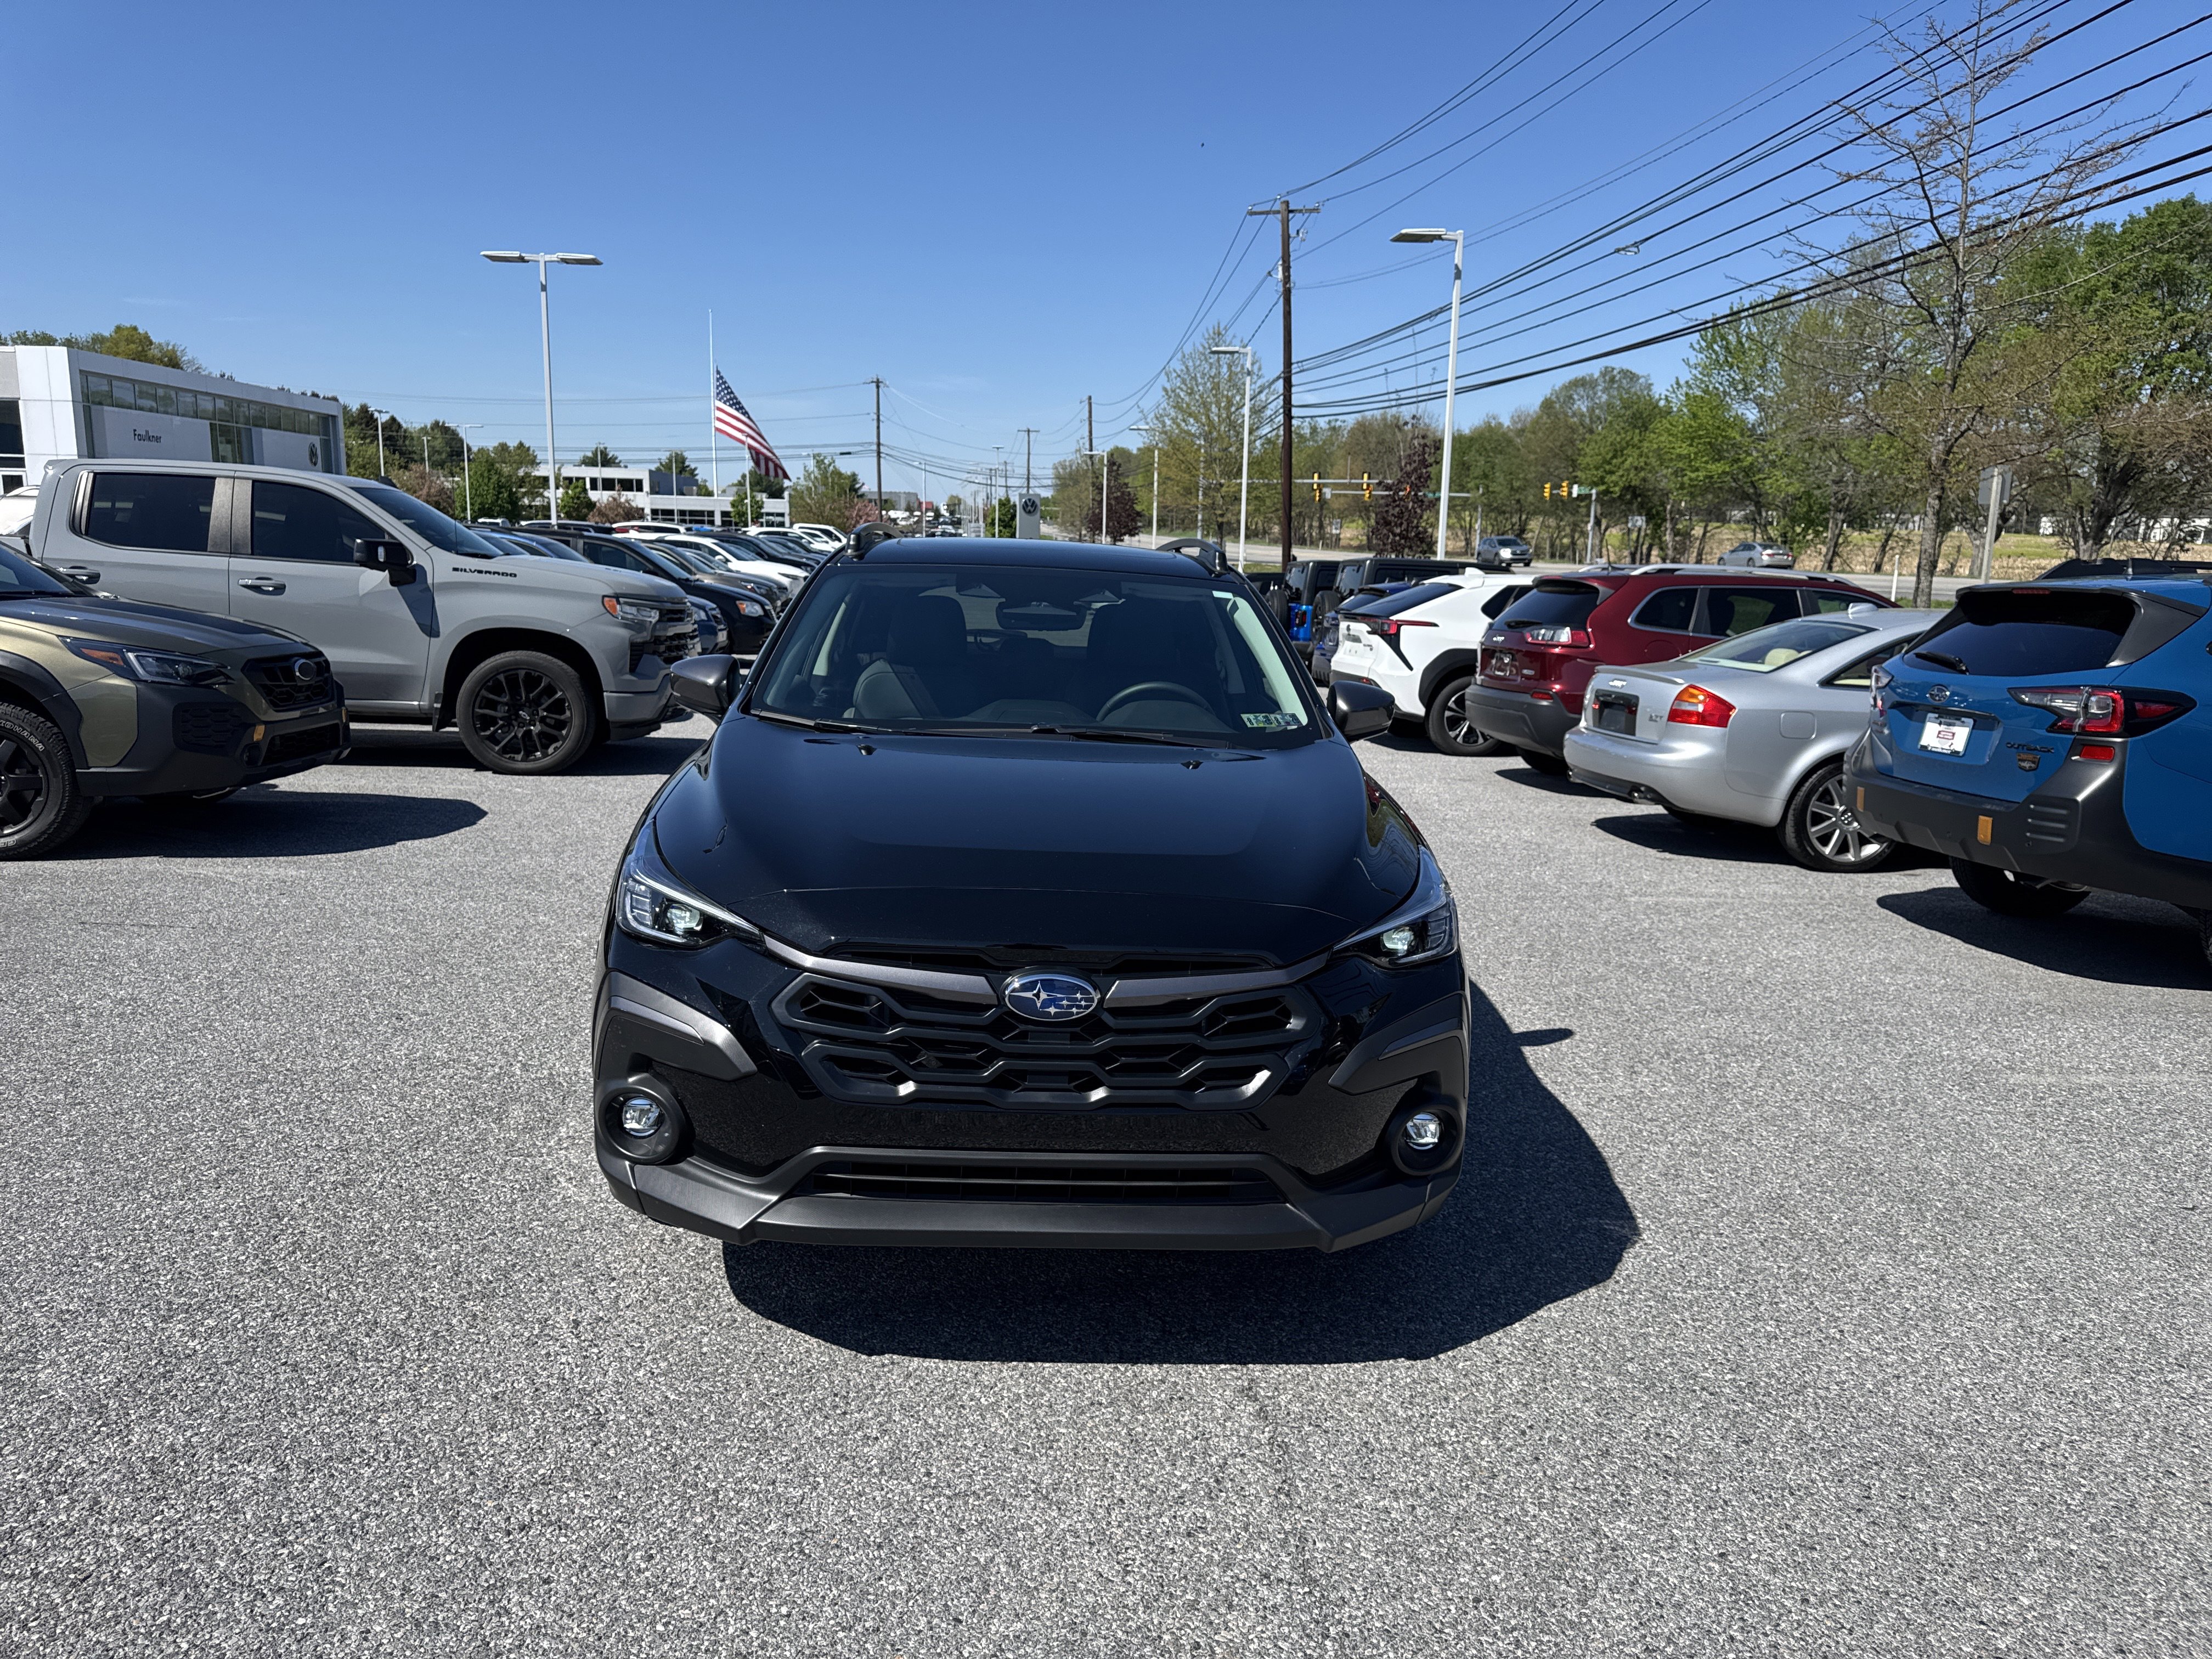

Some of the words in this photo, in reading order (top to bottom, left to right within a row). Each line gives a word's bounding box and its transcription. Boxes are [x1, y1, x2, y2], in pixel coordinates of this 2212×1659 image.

[133, 428, 162, 443] Faulkner
[452, 567, 517, 578] SILVERADO
[2006, 742, 2055, 753] OUTBACK
